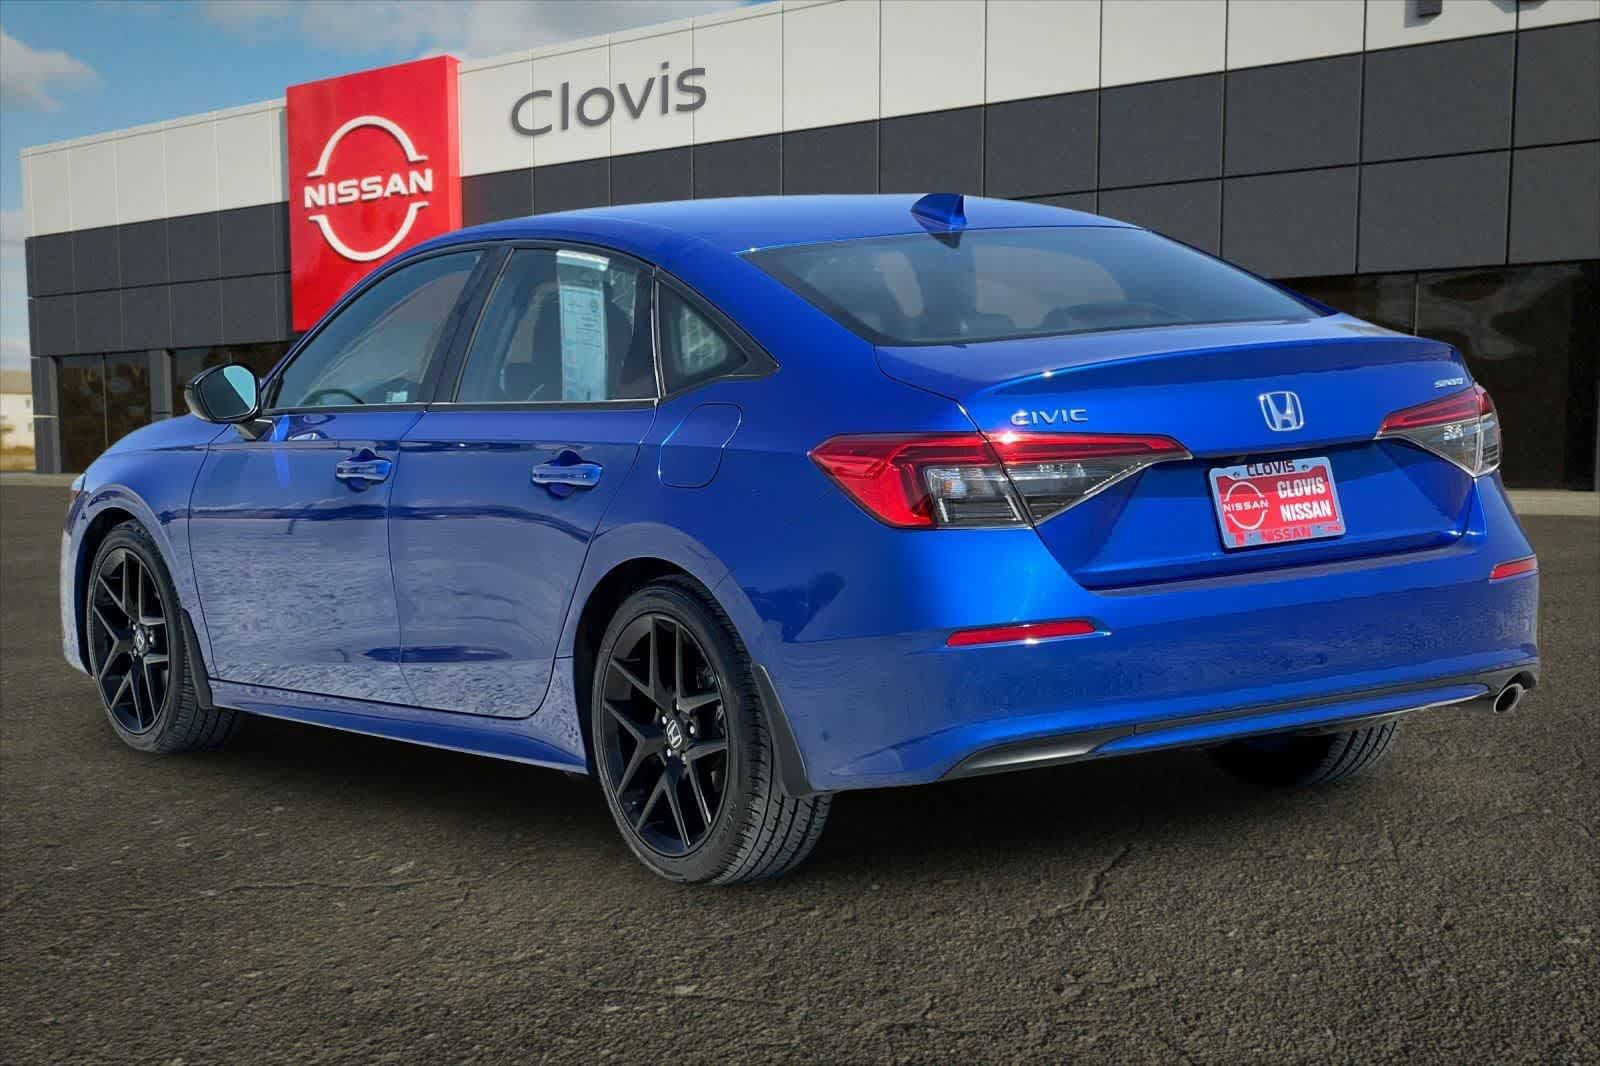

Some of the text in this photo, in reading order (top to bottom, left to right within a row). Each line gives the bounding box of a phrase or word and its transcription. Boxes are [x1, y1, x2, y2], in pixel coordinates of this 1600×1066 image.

[511, 62, 707, 136] Clovis
[304, 168, 433, 208] NISSAN
[1010, 408, 1089, 426] CIVIC
[1246, 460, 1296, 477] CLOVIS
[1277, 476, 1326, 499] CLOVIS
[1223, 499, 1269, 513] NISSAN
[1279, 500, 1332, 523] NISSAN
[1261, 526, 1312, 542] NISSAN
